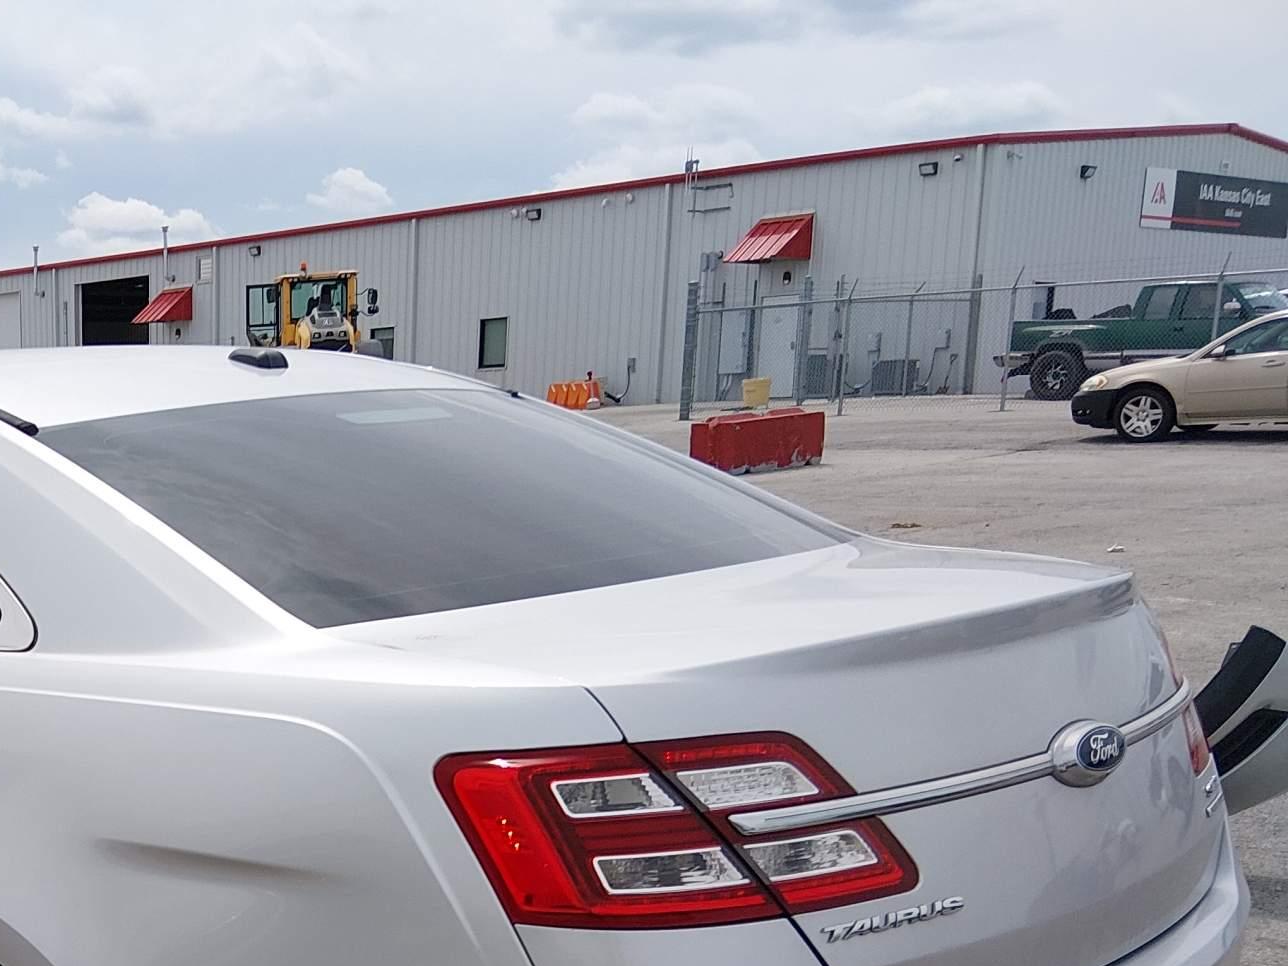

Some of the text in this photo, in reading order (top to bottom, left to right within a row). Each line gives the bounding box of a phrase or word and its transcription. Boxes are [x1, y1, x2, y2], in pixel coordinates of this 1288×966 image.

[1241, 187, 1256, 208] City
[1088, 733, 1121, 764] Ford
[821, 895, 965, 944] TAURUS
